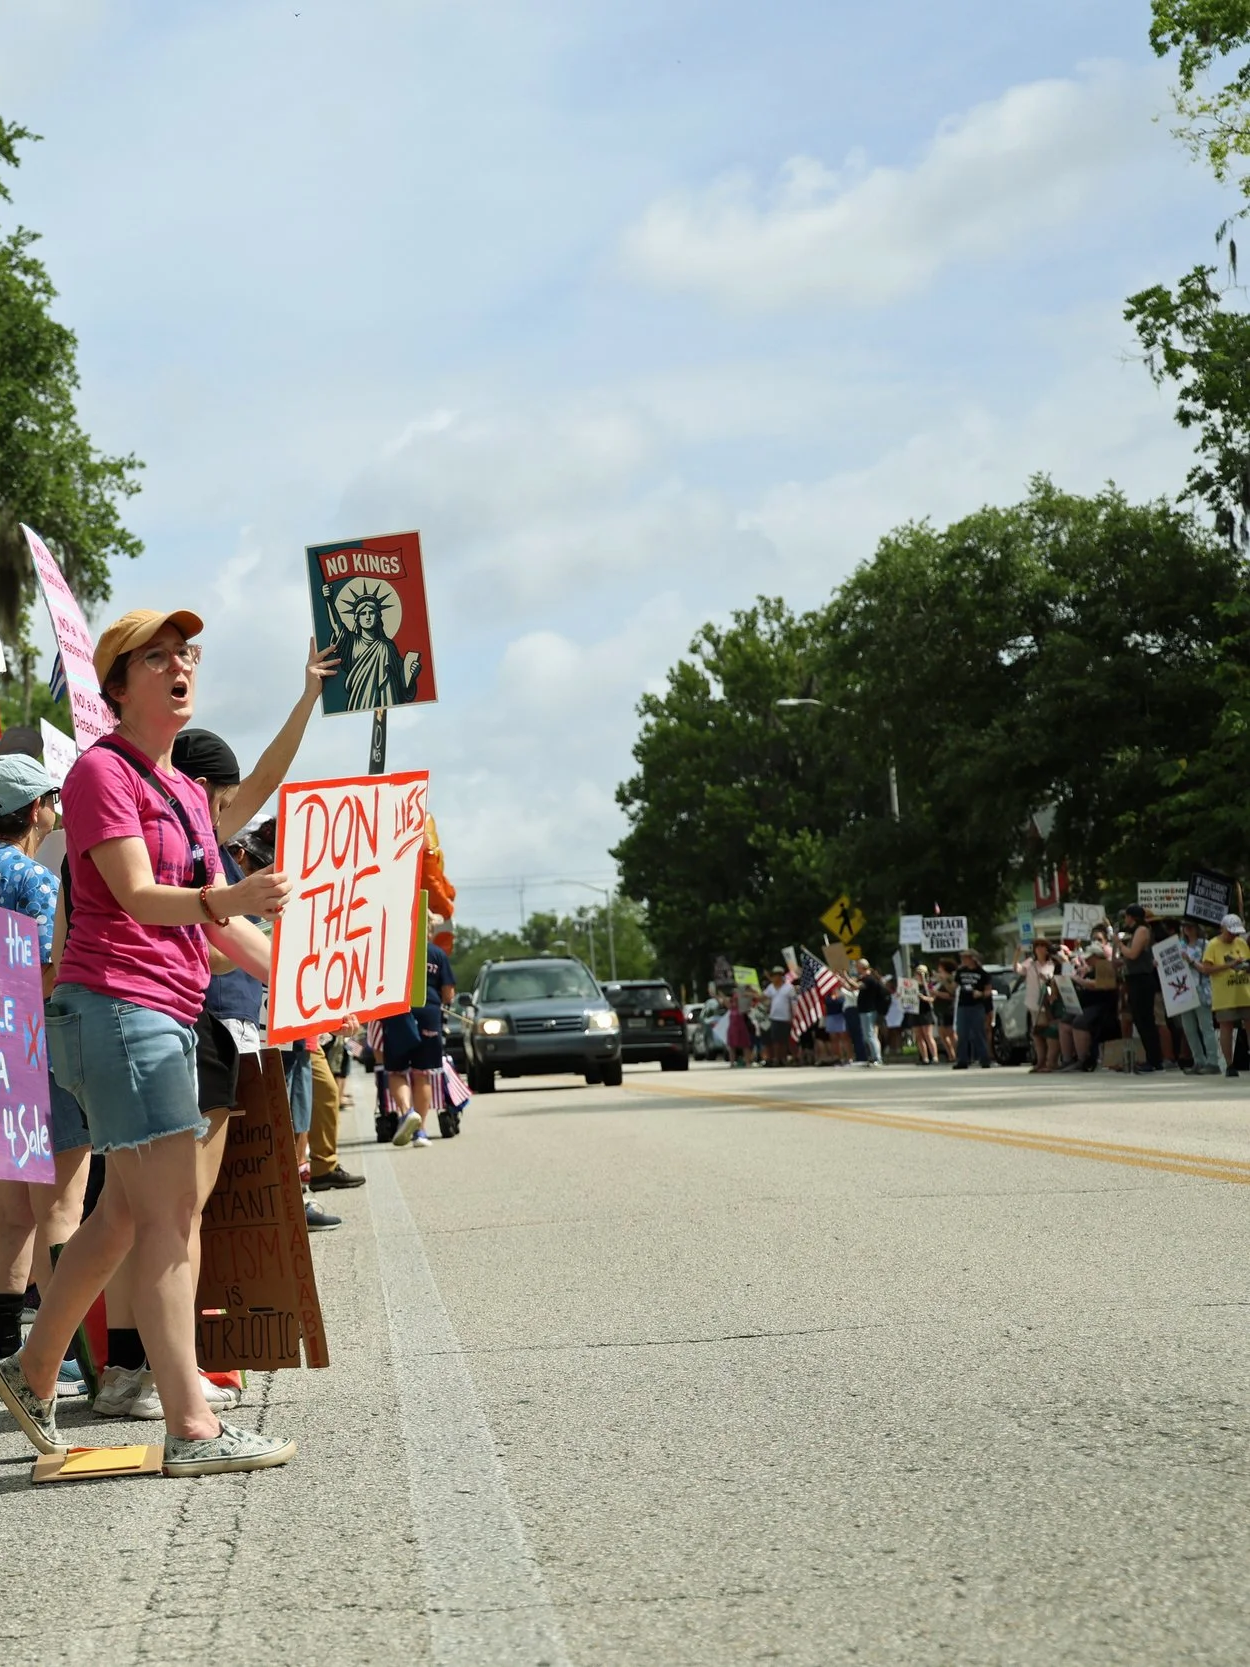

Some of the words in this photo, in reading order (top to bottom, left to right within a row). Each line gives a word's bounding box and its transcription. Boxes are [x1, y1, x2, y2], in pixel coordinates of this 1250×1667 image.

[325, 554, 348, 577] NO
[352, 553, 401, 574] KINGS
[294, 786, 380, 880] DON
[393, 785, 426, 840] LIES
[299, 865, 381, 955] THE
[922, 919, 964, 930] IMPEACH
[295, 905, 387, 1020] CON!
[930, 938, 960, 949] FIRST!
[223, 1155, 268, 1194] your
[202, 1183, 280, 1223] ATANT
[204, 1228, 285, 1287] CISM
[225, 1285, 244, 1308] is
[195, 1311, 298, 1361] ATRIOTIC
